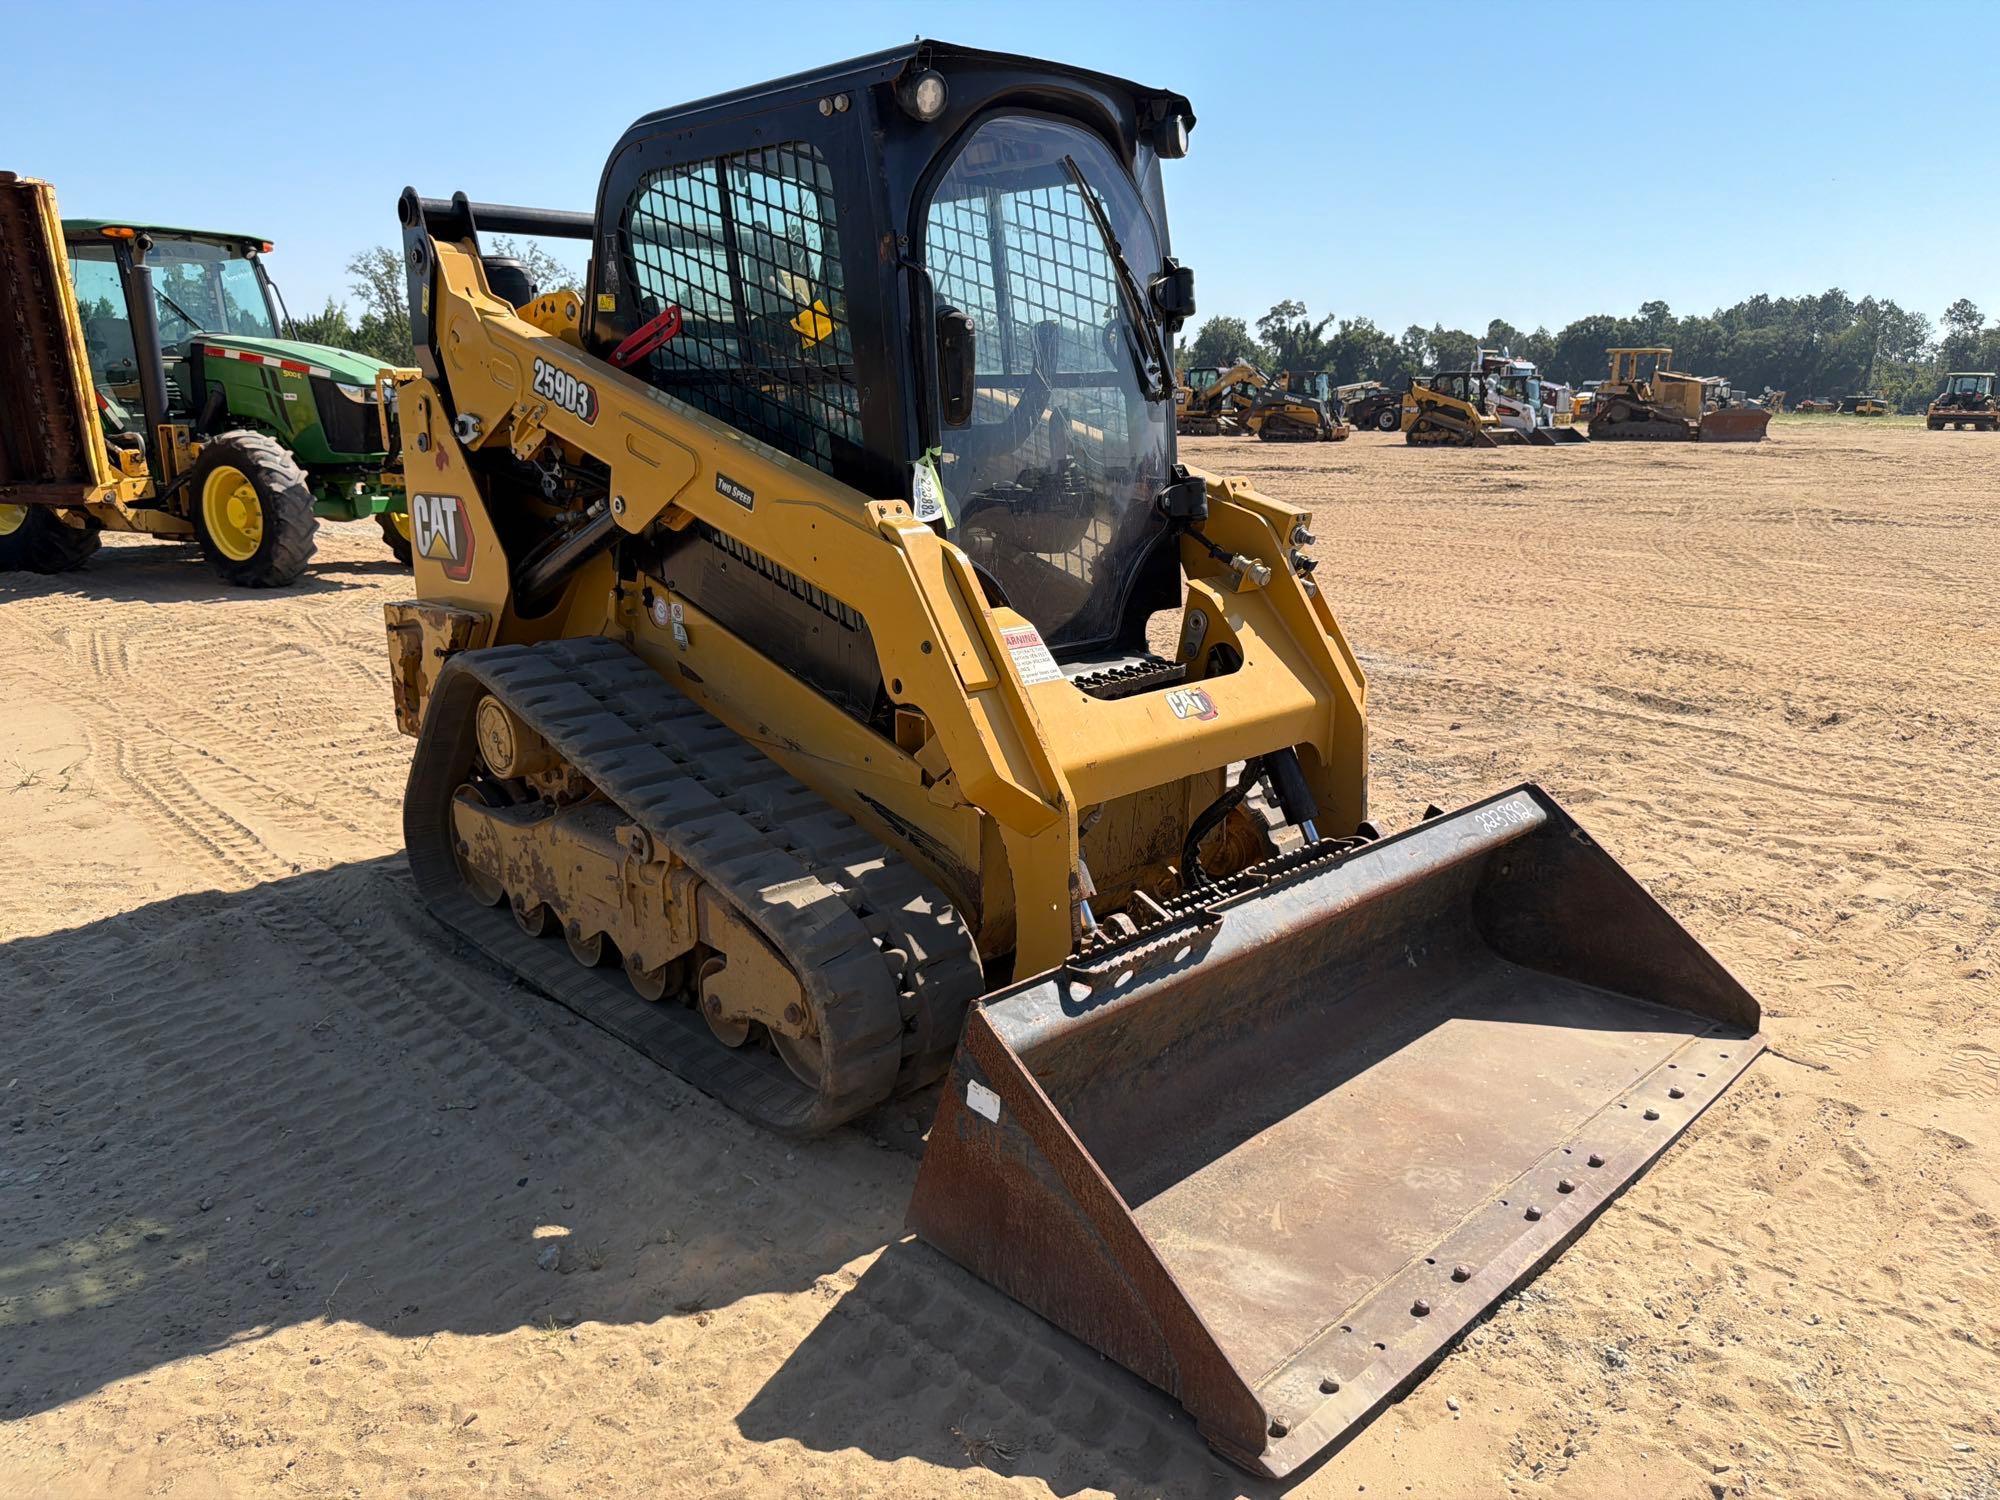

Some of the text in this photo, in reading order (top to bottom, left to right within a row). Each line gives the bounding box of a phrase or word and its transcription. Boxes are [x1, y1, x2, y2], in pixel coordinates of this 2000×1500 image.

[533, 357, 589, 419] 259D3
[718, 478, 752, 504] TWO SPEED
[920, 478, 936, 516] 223882
[413, 494, 458, 560] CAT
[1165, 688, 1207, 719] CAT
